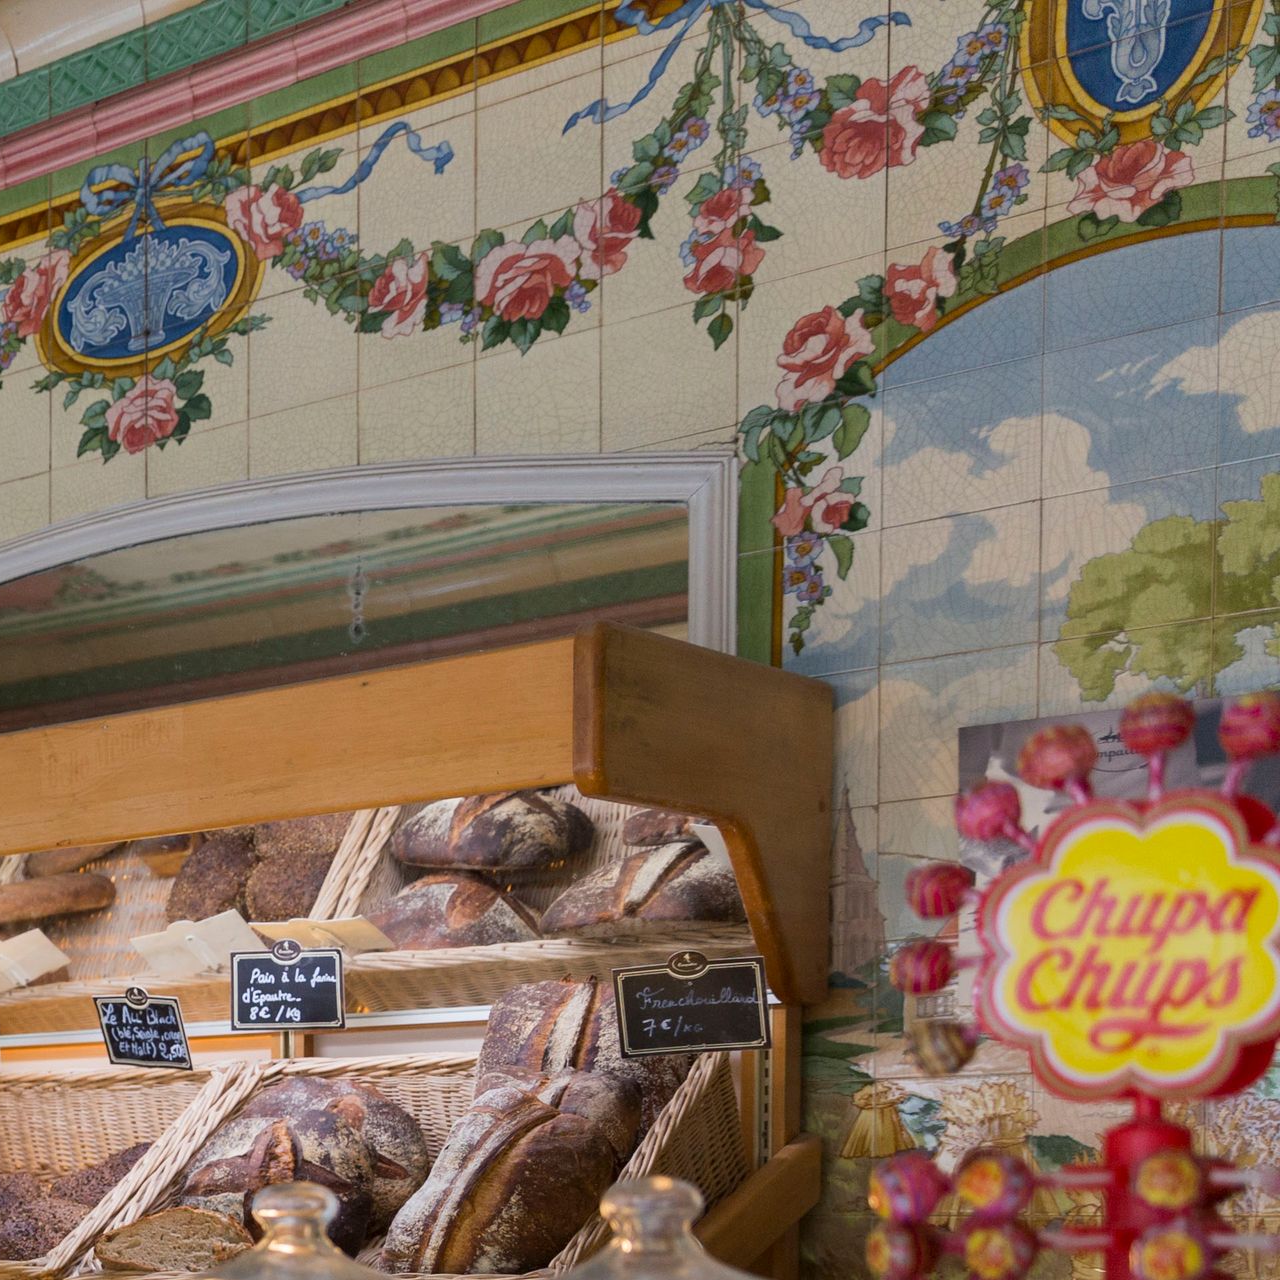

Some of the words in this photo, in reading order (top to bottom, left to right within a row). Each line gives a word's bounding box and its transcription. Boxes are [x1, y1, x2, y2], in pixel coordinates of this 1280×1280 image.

[1029, 877, 1262, 954] Chupa
[249, 967, 275, 984] Pain
[281, 970, 290, 983] à
[294, 967, 306, 982] la
[1015, 944, 1246, 1053] Chups
[146, 1006, 177, 1026] Black
